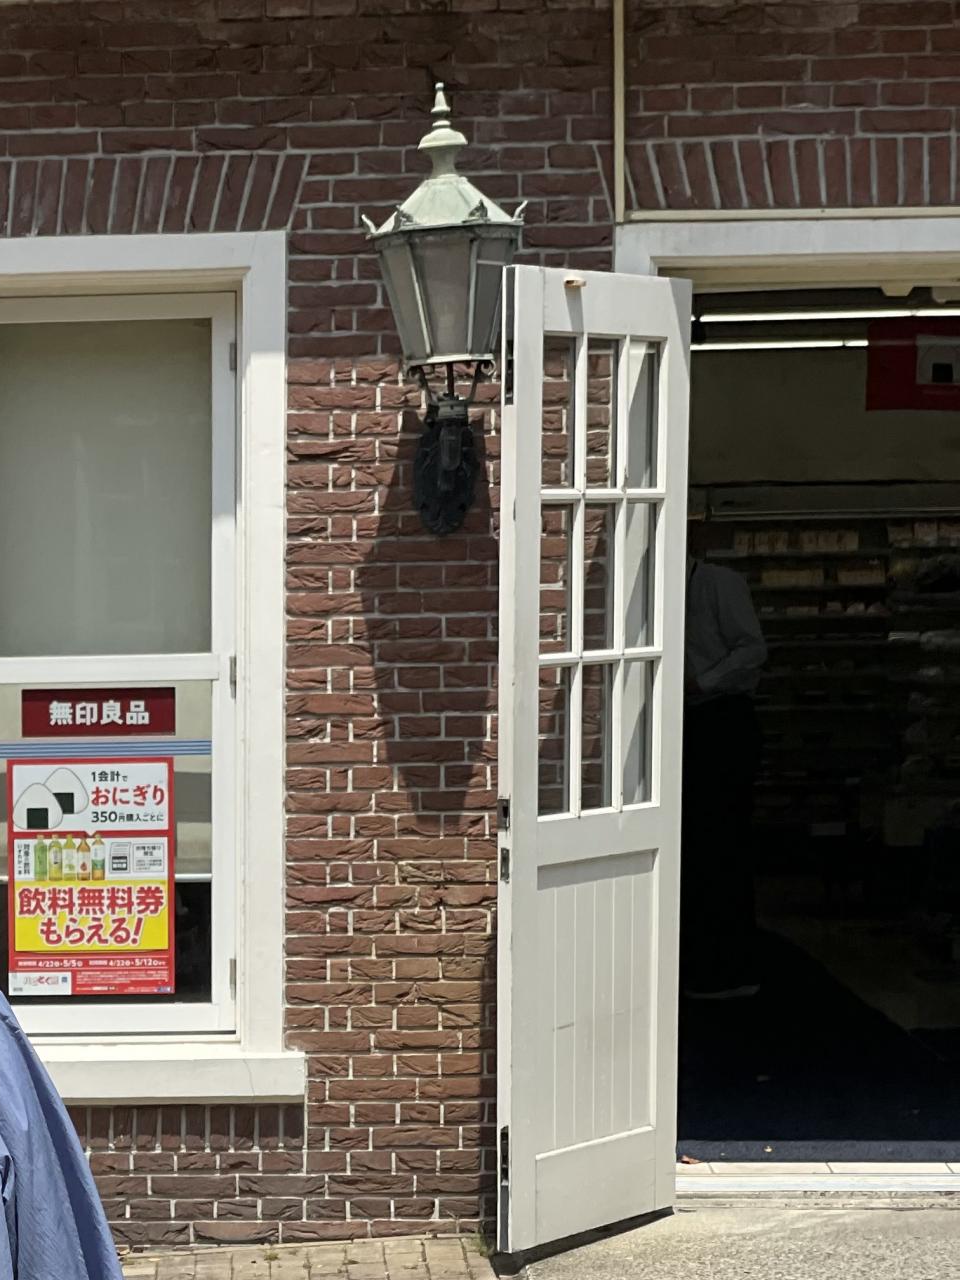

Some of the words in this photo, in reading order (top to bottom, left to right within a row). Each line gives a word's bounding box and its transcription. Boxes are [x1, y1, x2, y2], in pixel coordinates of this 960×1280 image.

[49, 700, 150, 726] 無印良品
[91, 771, 128, 782] 1会計で
[91, 784, 165, 807] おにぎり
[17, 886, 164, 916] 飲料無料券
[40, 917, 144, 945] もらえる!
